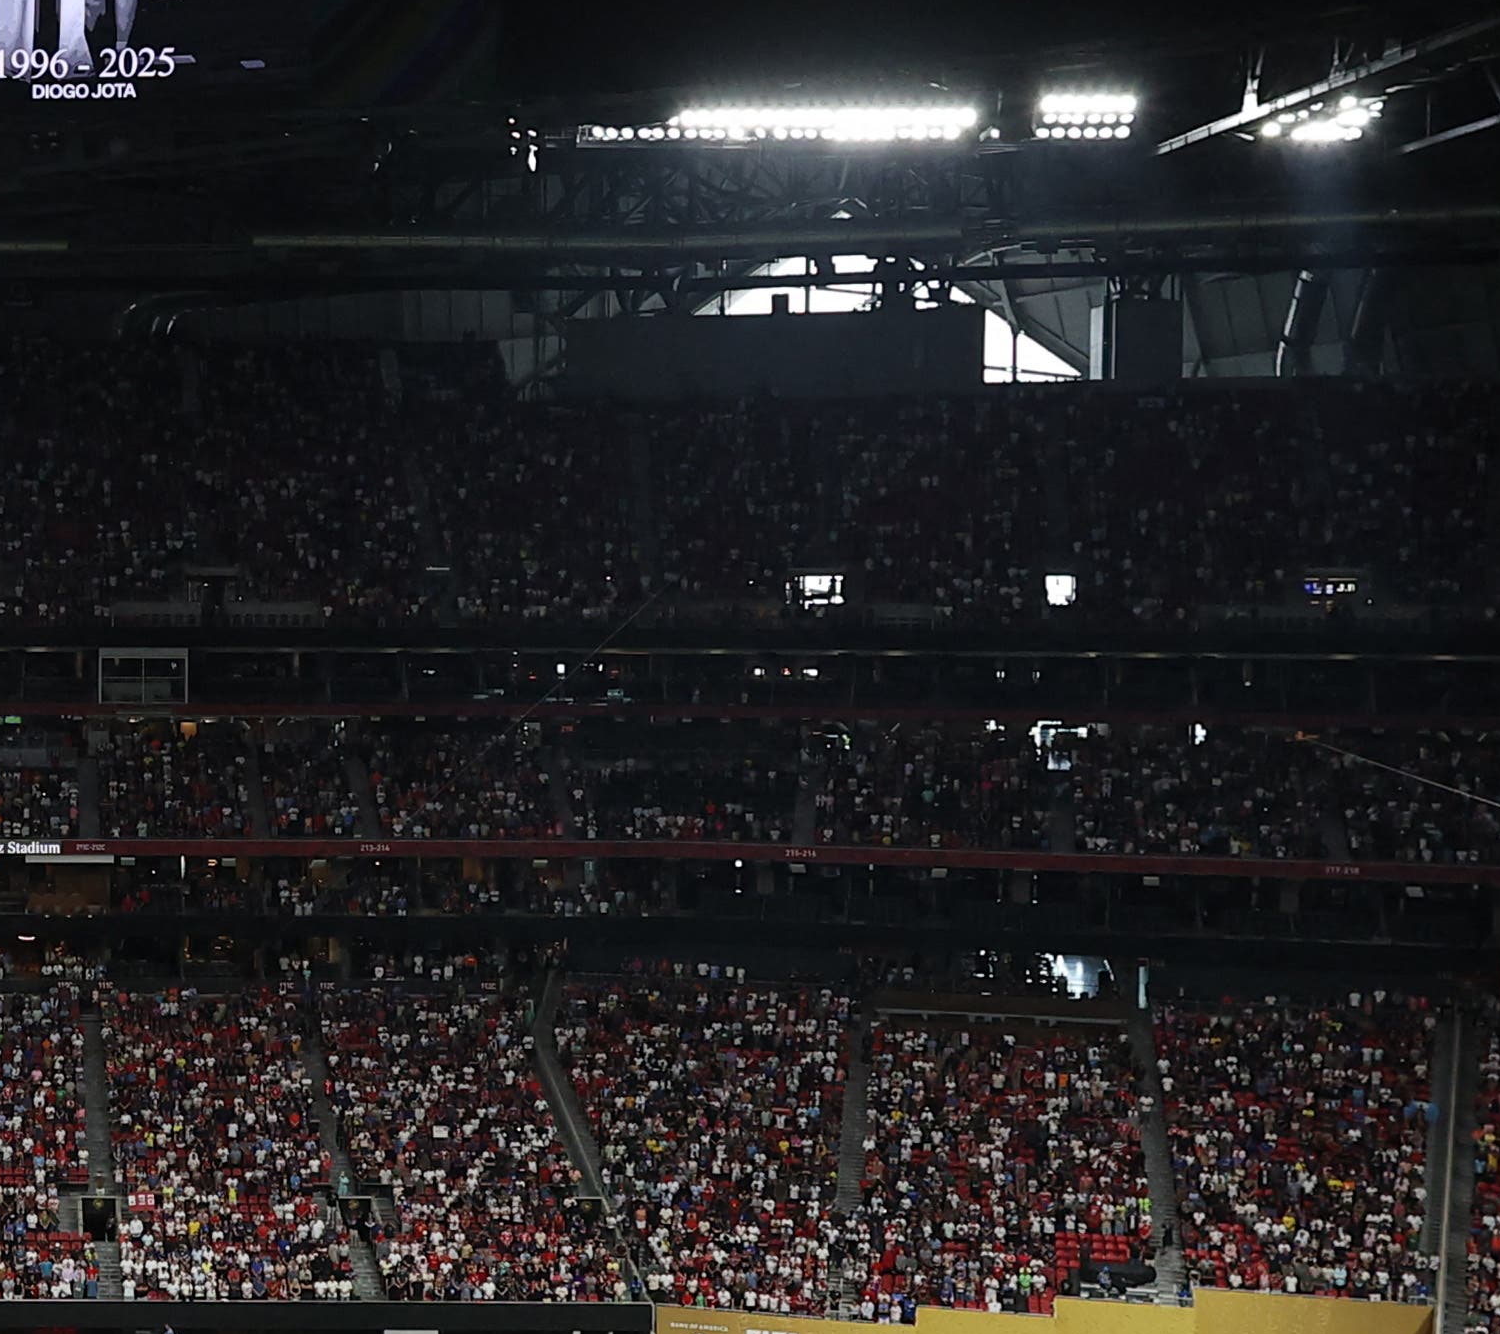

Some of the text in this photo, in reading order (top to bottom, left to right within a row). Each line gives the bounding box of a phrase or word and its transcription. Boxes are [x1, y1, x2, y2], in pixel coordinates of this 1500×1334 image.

[98, 47, 175, 78] 2025
[32, 82, 136, 100] DIOGO JOTA
[7, 840, 61, 855] Stadium
